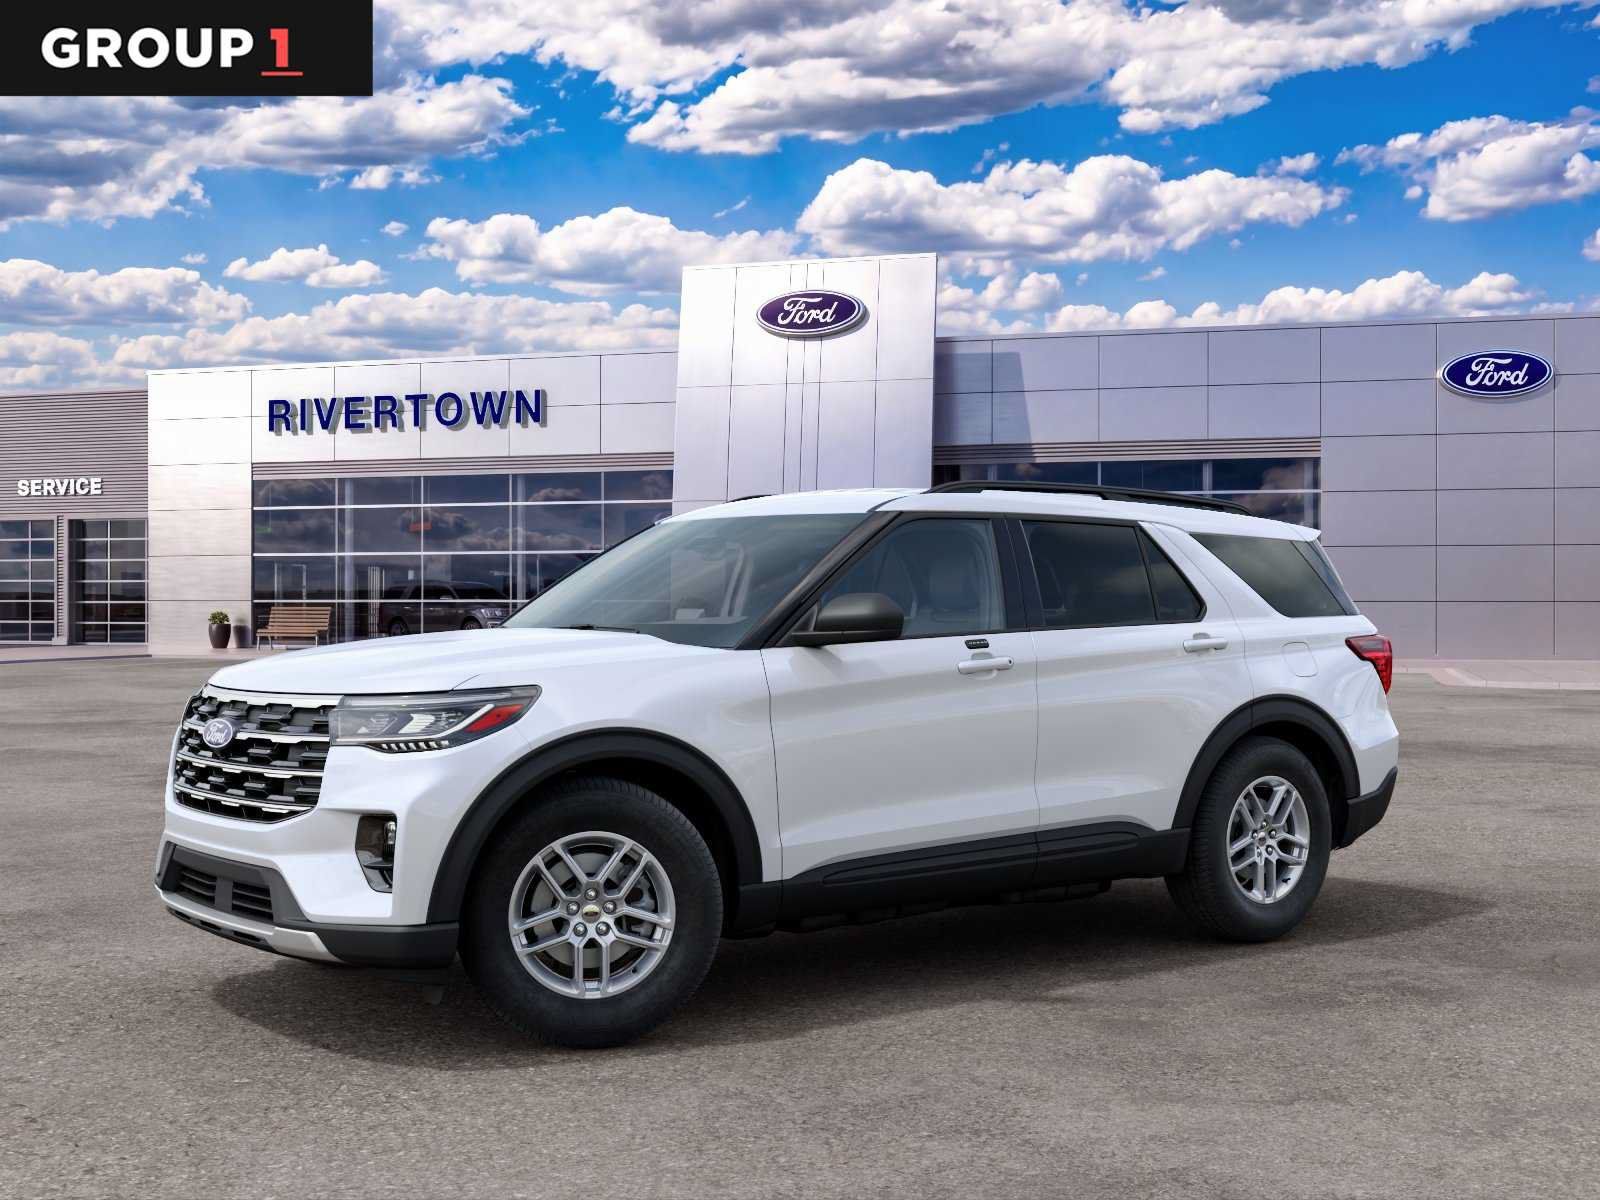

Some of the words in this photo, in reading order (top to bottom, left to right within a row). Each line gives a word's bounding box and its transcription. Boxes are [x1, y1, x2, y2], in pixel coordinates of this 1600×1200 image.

[777, 296, 839, 325] Ford
[1465, 357, 1530, 386] Ford
[268, 389, 541, 432] RIVERTOWN
[17, 477, 102, 497] SERVICE
[206, 722, 228, 744] Ford
